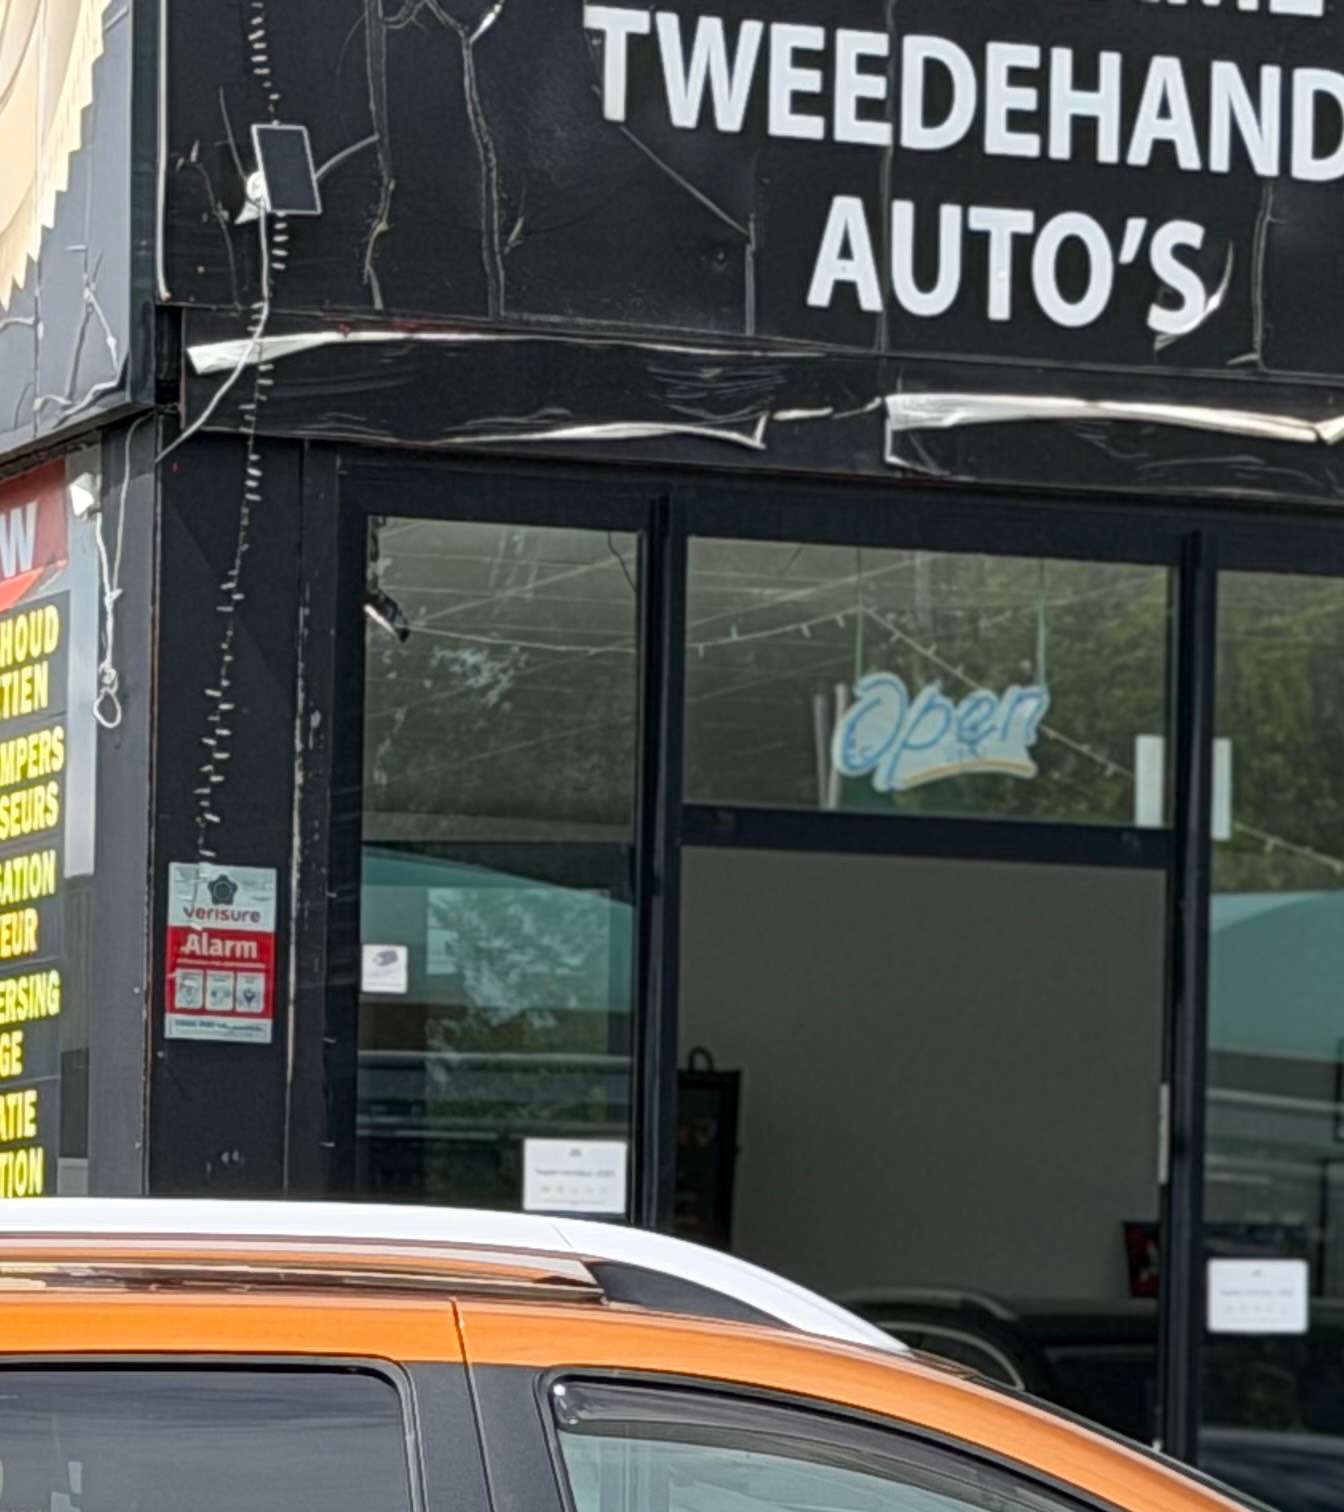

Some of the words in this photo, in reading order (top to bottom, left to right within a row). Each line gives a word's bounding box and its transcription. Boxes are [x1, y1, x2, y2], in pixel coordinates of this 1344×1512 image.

[835, 674, 1049, 790] Open
[183, 906, 261, 923] verisure
[184, 932, 258, 959] Alarm
